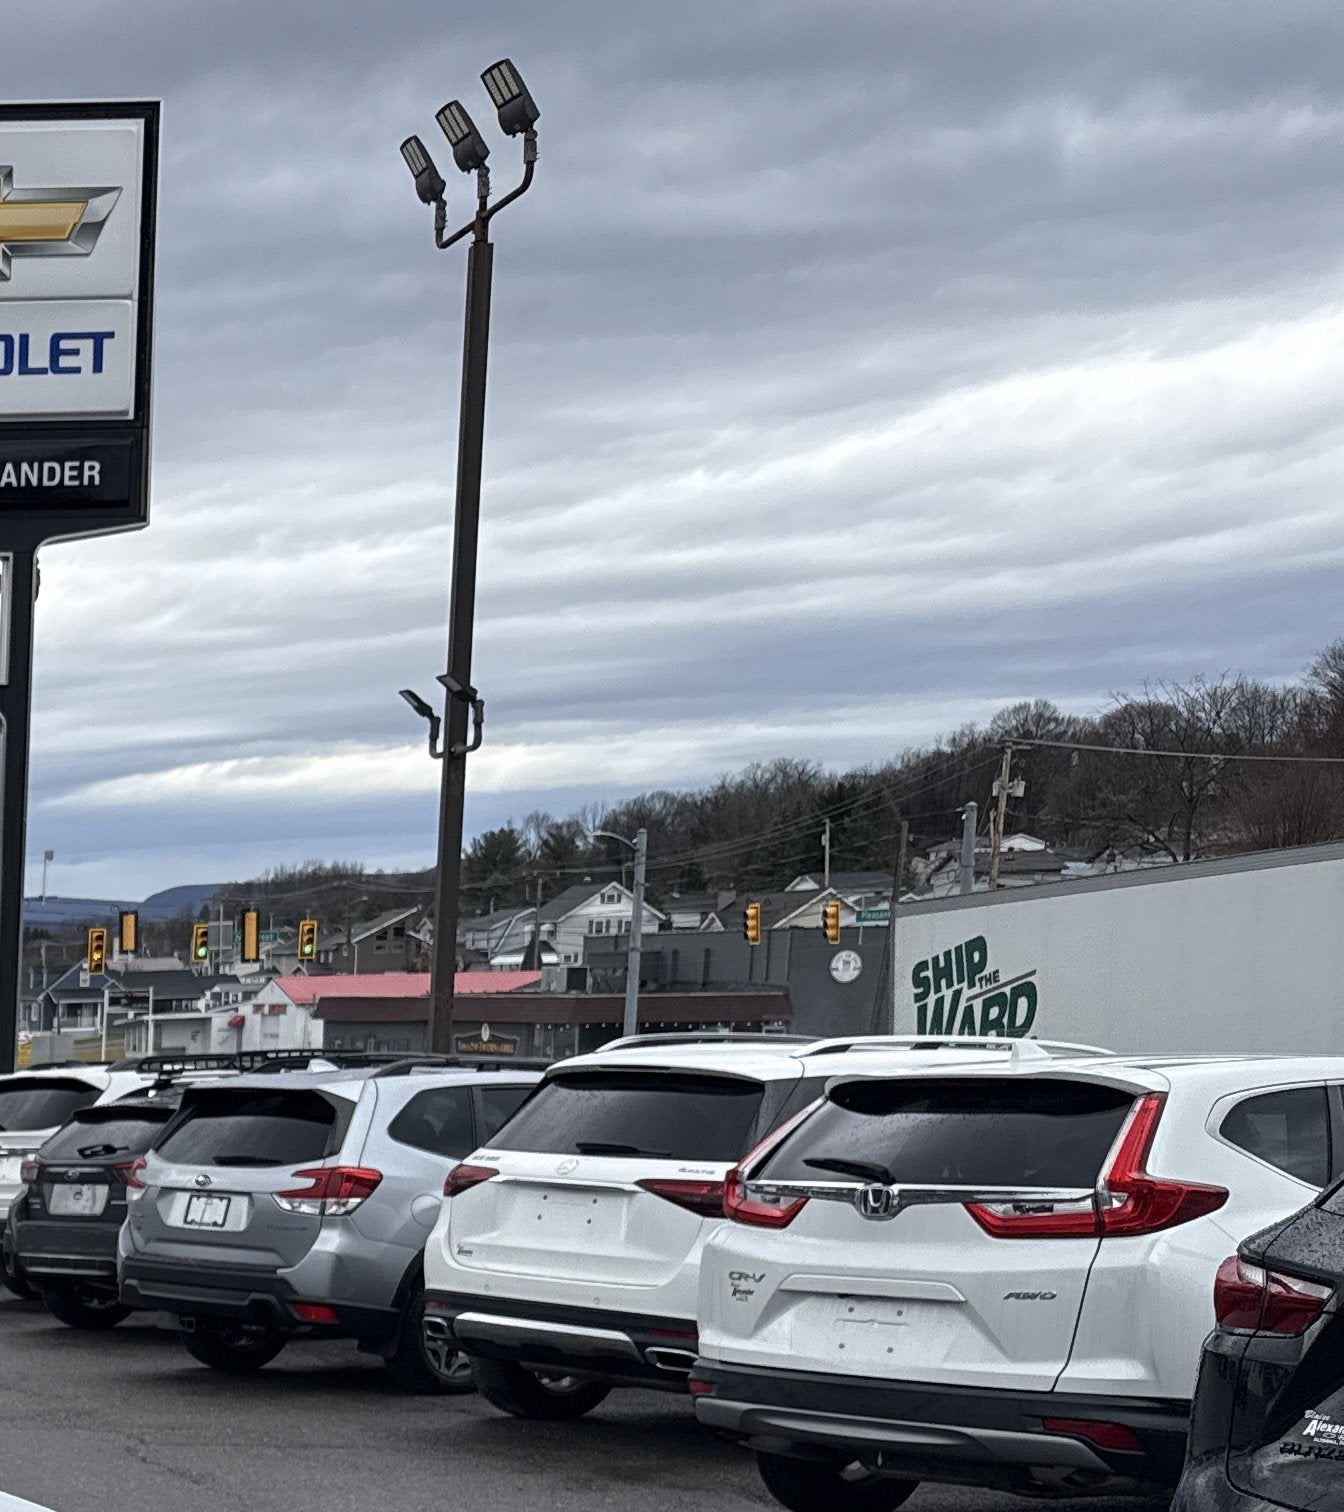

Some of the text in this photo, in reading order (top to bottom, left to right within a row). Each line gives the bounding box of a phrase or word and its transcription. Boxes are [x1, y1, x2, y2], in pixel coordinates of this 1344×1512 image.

[912, 935, 988, 1004] SHIP
[977, 969, 1001, 989] THE
[917, 981, 1038, 1038] WARD
[728, 1271, 766, 1283] CR-V
[1003, 1291, 1057, 1300] AWD
